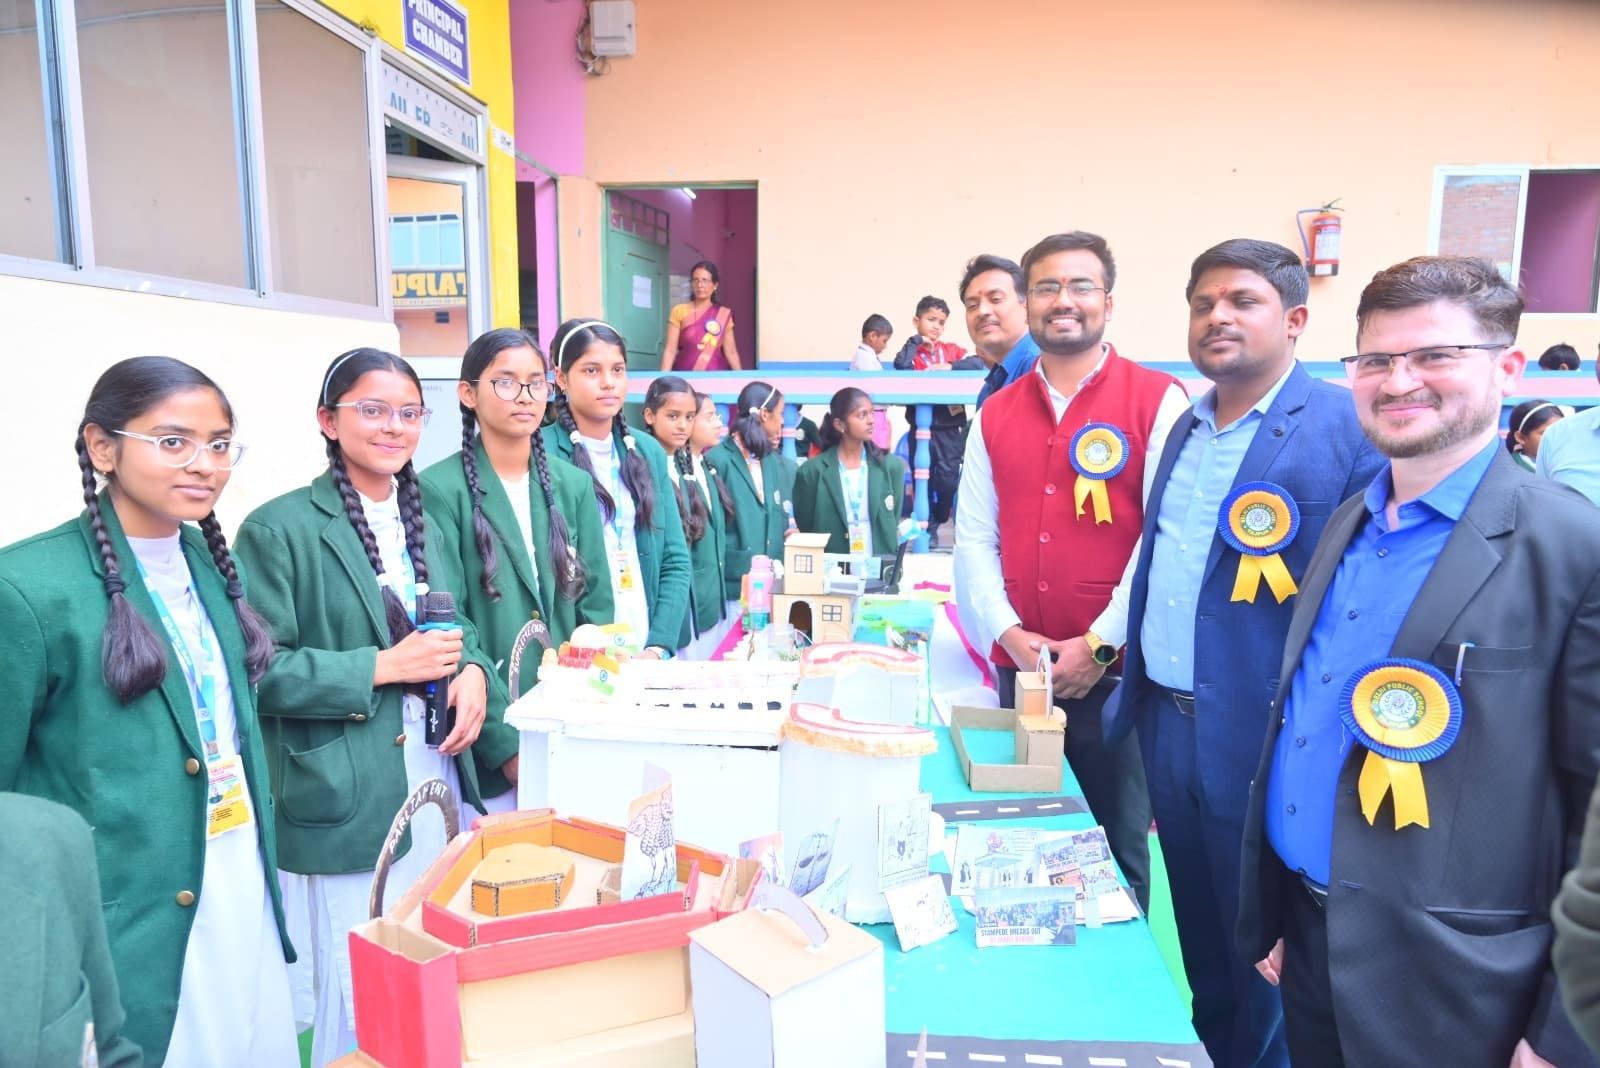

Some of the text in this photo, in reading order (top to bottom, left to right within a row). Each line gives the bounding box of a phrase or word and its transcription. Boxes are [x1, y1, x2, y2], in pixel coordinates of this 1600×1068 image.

[413, 18, 463, 69] CHAMBER
[1386, 682, 1414, 693] PUBLIC
[1413, 691, 1425, 718] SCHOOL
[981, 928, 1008, 936] STAMPEDE
